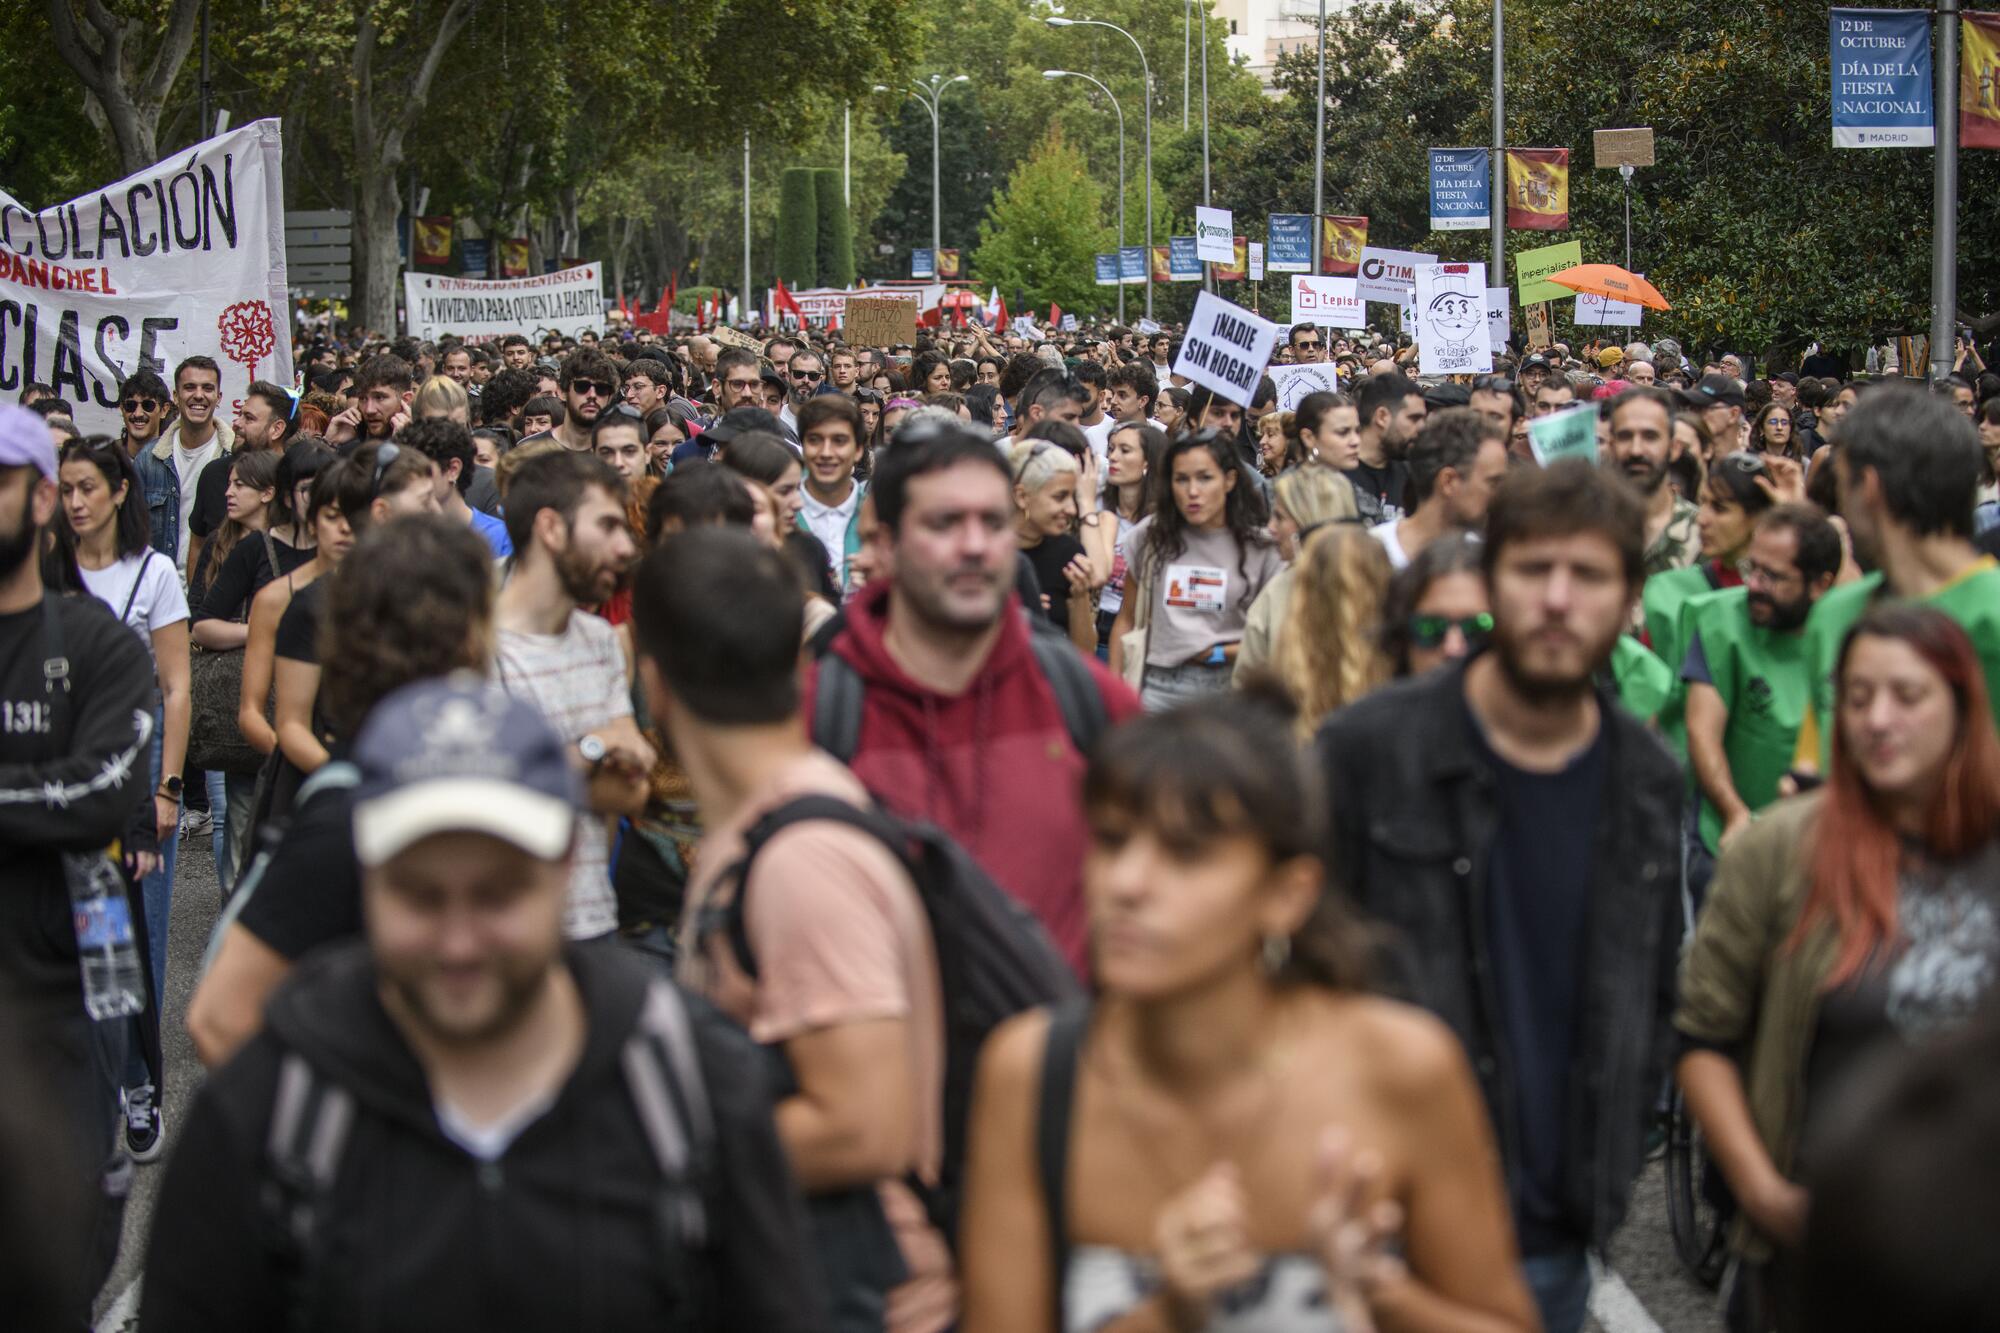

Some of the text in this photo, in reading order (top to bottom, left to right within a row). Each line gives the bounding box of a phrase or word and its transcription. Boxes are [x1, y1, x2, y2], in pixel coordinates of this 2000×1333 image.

[1841, 21, 1873, 32] 12 DE
[1840, 37, 1906, 49] OCTUBRE
[1841, 61, 1919, 76] DÍA DE LA
[1842, 82, 1895, 95] FIESTA
[1842, 101, 1926, 114] NACIONAL
[1870, 133, 1908, 142] MADRID
[1435, 155, 1455, 163] 12 DE
[1435, 164, 1474, 172] OCTUBRE
[1436, 178, 1482, 188] DÍA DE LA
[1436, 191, 1468, 200] FIESTA
[2, 151, 238, 262] CULACIÓN
[1436, 202, 1486, 211] NACIONAL
[1521, 260, 1578, 280] imperialista
[524, 269, 583, 288] RENTISTAS
[1322, 293, 1359, 307] tepiso
[421, 288, 603, 326] LA VIVIENDA PARA QUIEN LA HABITA
[1211, 313, 1258, 353] ¡NADIE
[1184, 338, 1258, 393] SIN HOGAR!
